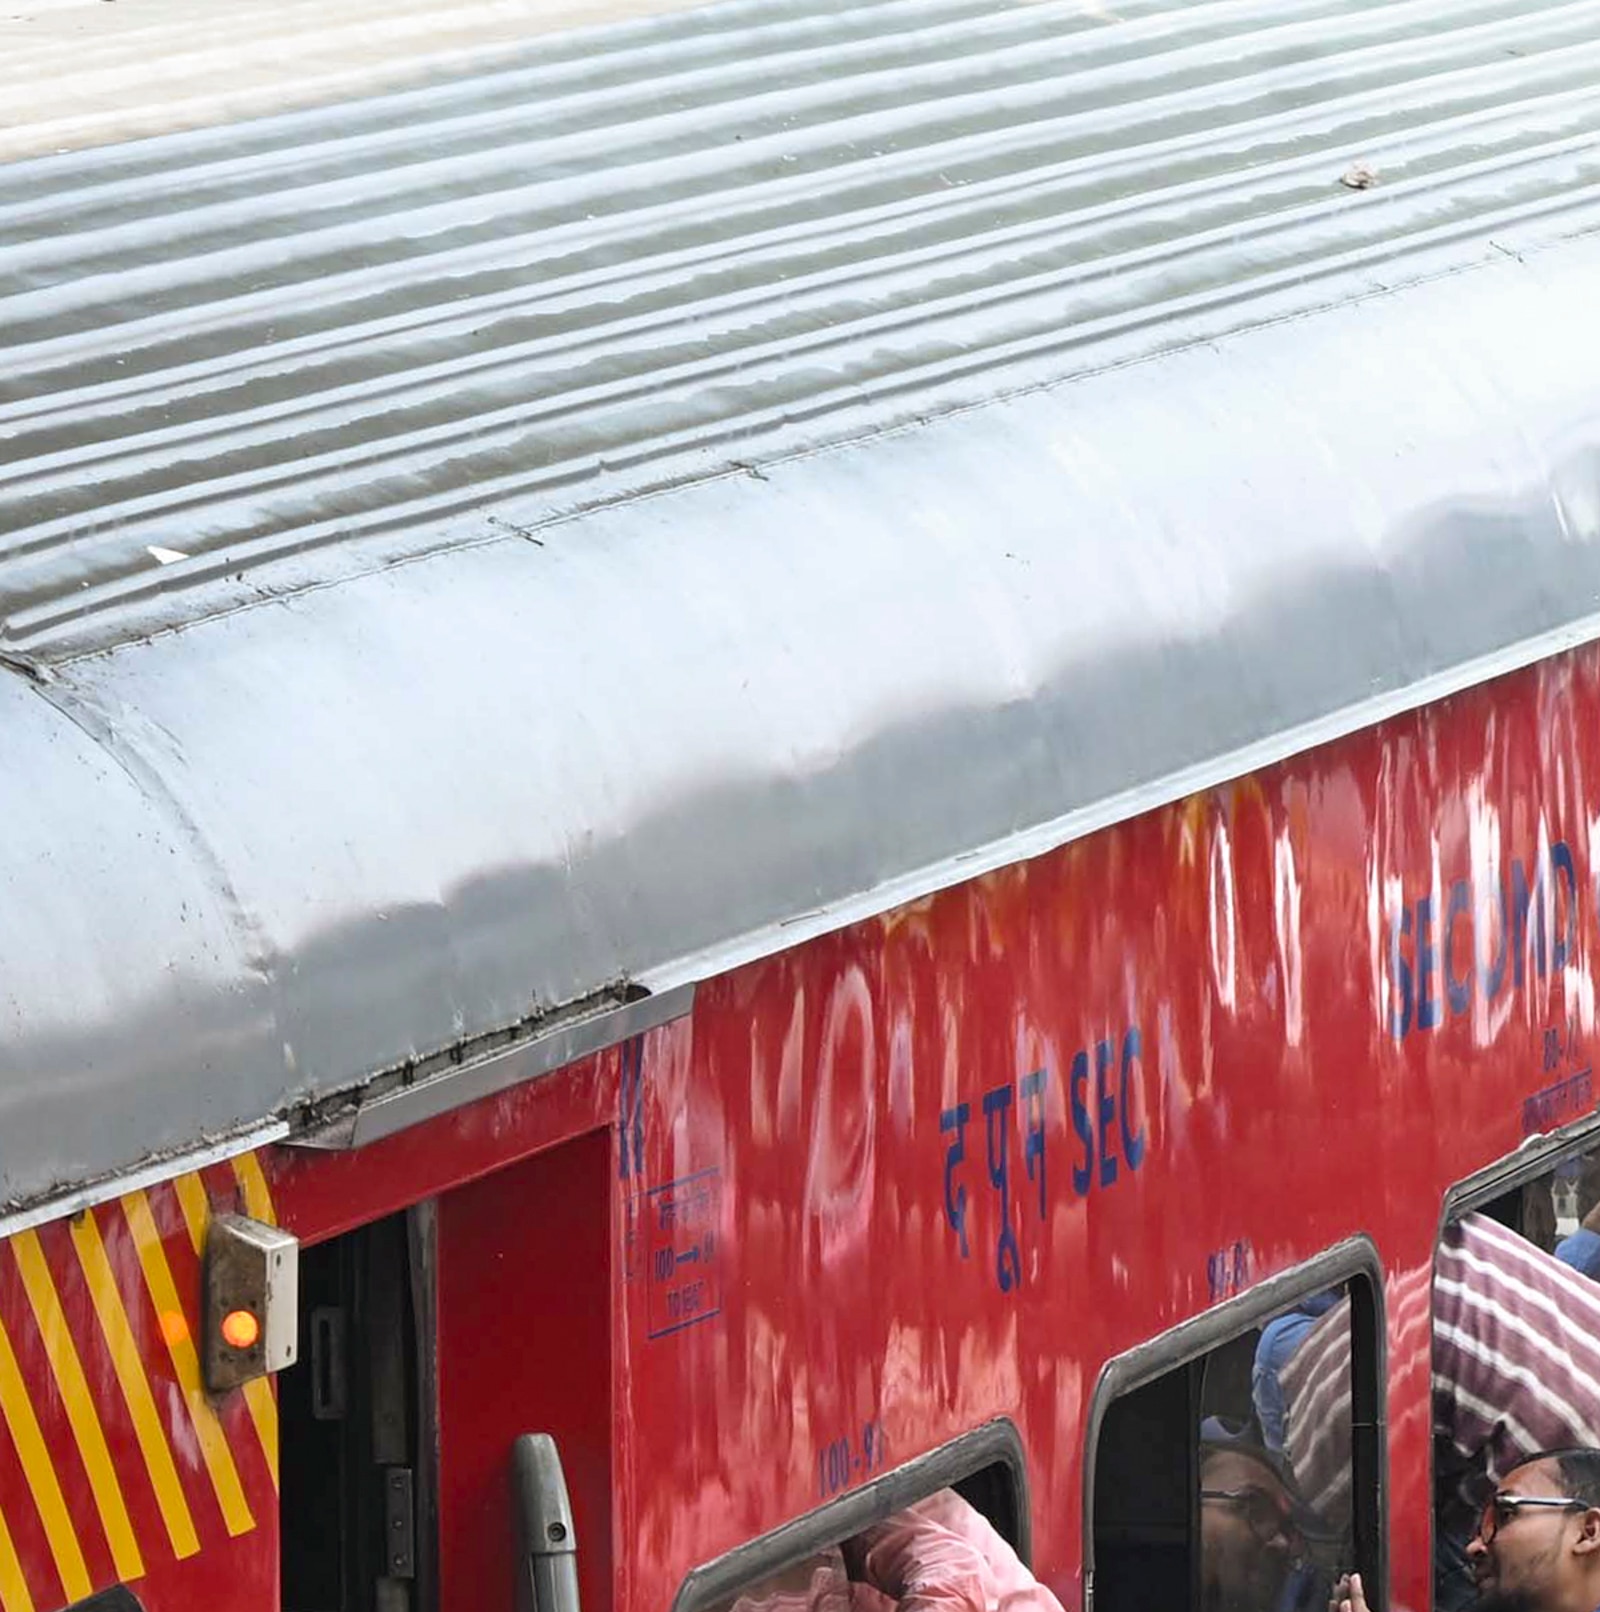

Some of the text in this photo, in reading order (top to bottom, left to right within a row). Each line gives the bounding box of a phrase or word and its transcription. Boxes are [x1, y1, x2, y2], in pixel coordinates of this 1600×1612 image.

[1390, 841, 1577, 1042] SECOND
[940, 1103, 969, 1258] द
[983, 1085, 1021, 1292] पू
[1071, 1026, 1145, 1196] SEC
